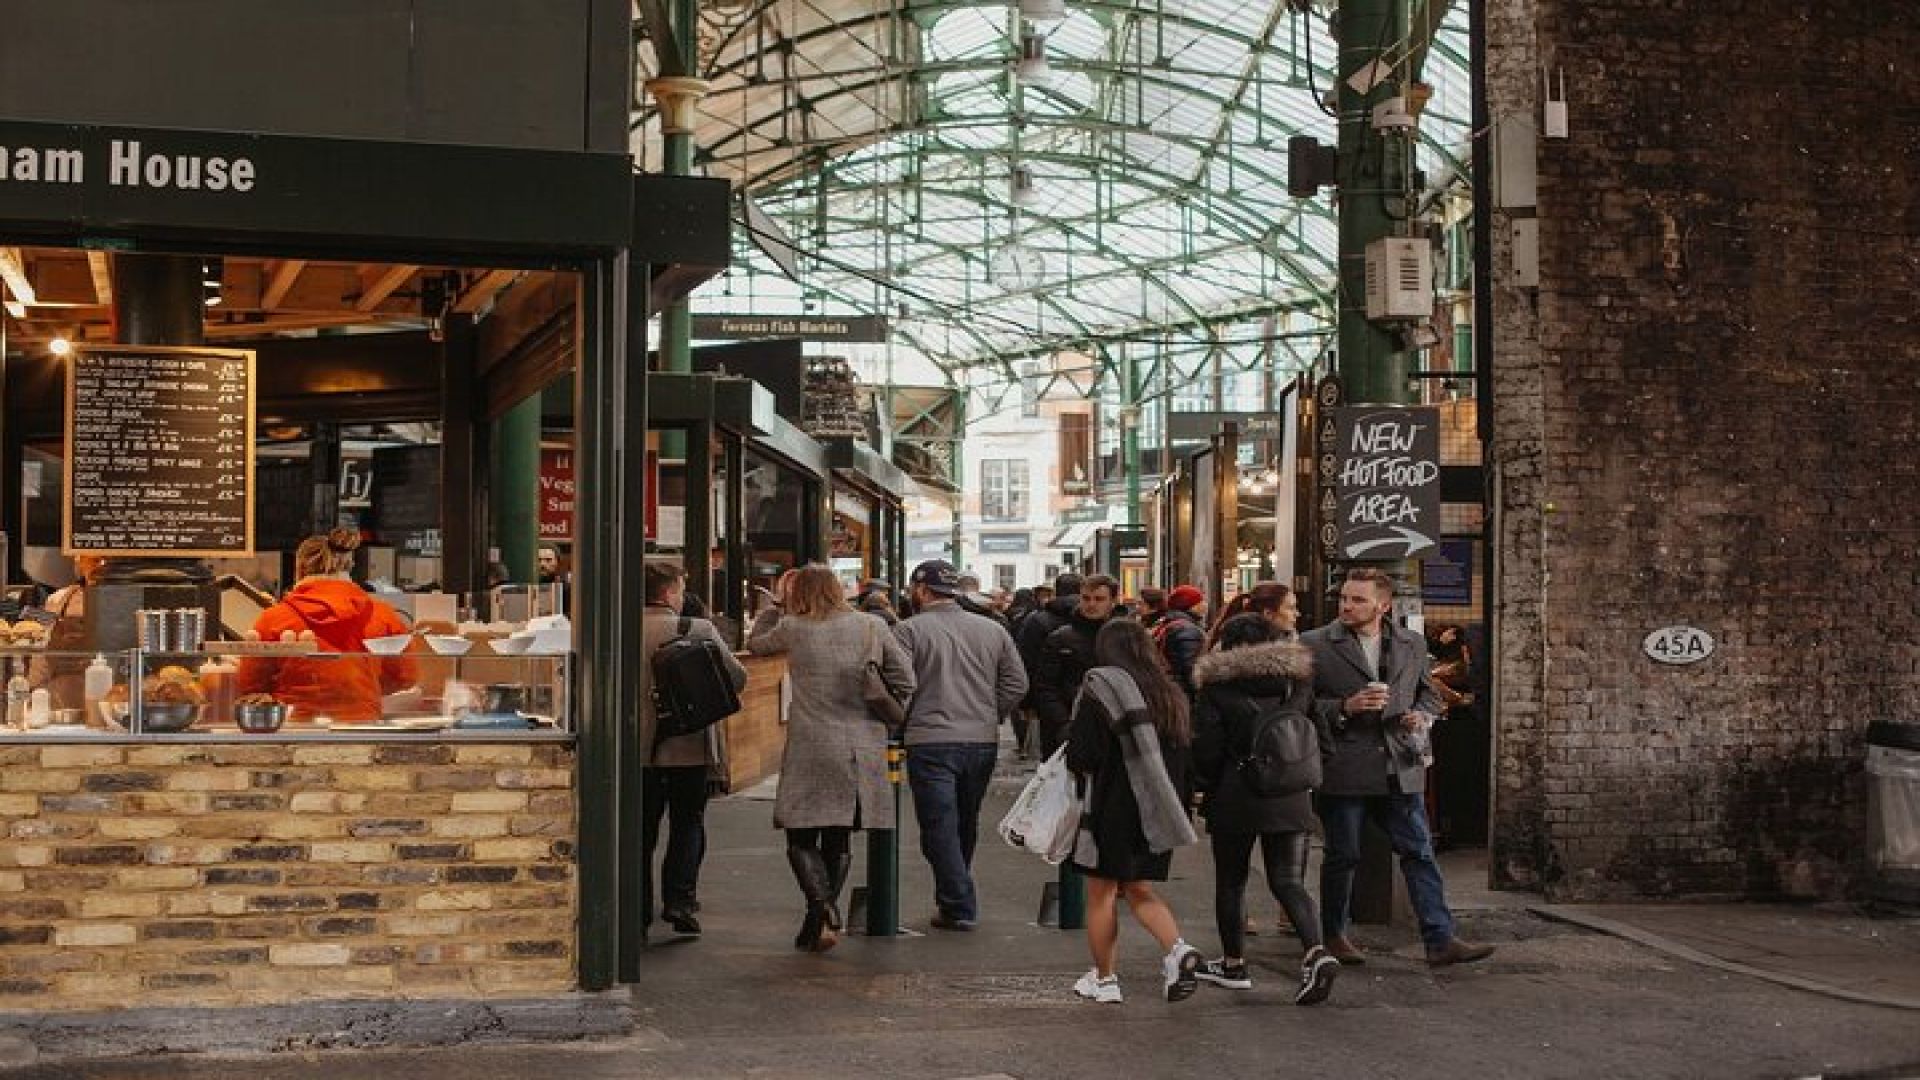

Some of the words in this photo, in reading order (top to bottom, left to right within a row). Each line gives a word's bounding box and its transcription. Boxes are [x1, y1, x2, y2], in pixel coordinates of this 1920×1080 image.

[109, 139, 256, 191] House
[1351, 422, 1427, 453] NEW
[1338, 456, 1380, 487] HOT
[1381, 456, 1439, 487] FOOD
[1348, 493, 1420, 524] AREA
[1653, 634, 1705, 656] 45A
